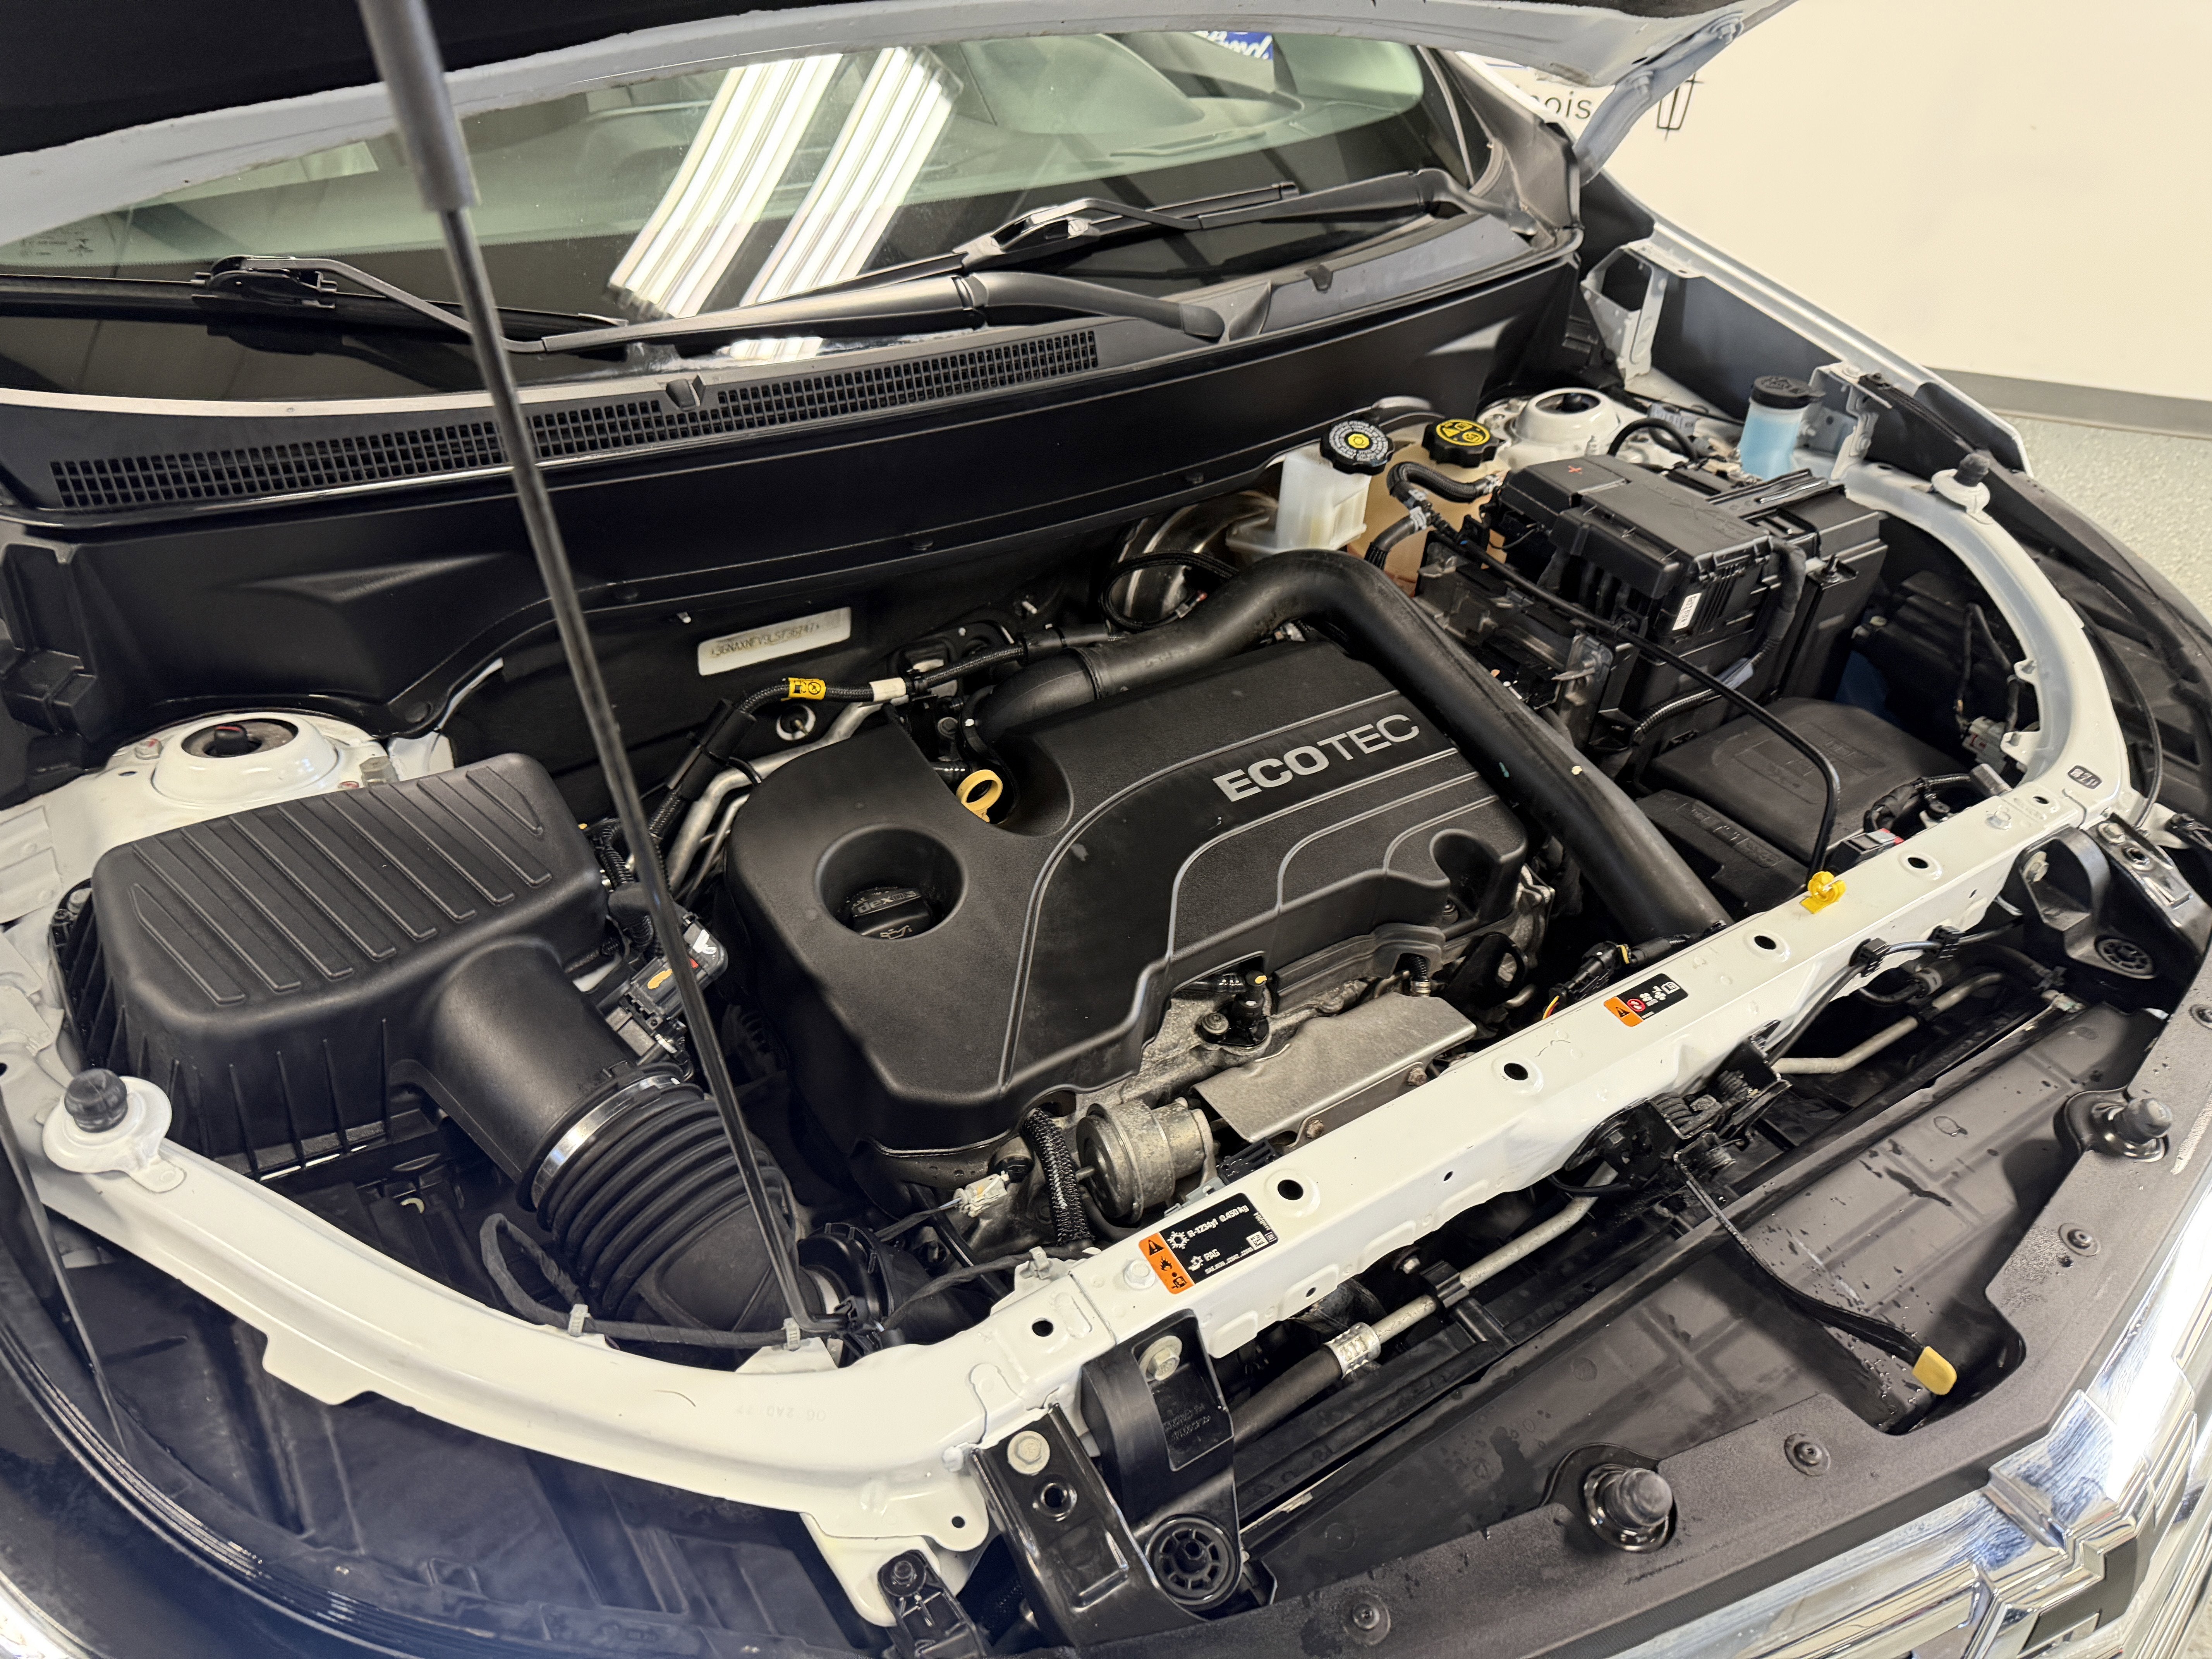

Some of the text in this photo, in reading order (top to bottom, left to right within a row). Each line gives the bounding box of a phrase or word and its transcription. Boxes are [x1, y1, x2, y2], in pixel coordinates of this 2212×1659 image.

[1212, 714, 1420, 802] ECOTEC
[857, 890, 917, 914] dexos
[1237, 1204, 1249, 1214] kg
[1203, 1249, 1220, 1262] PAG
